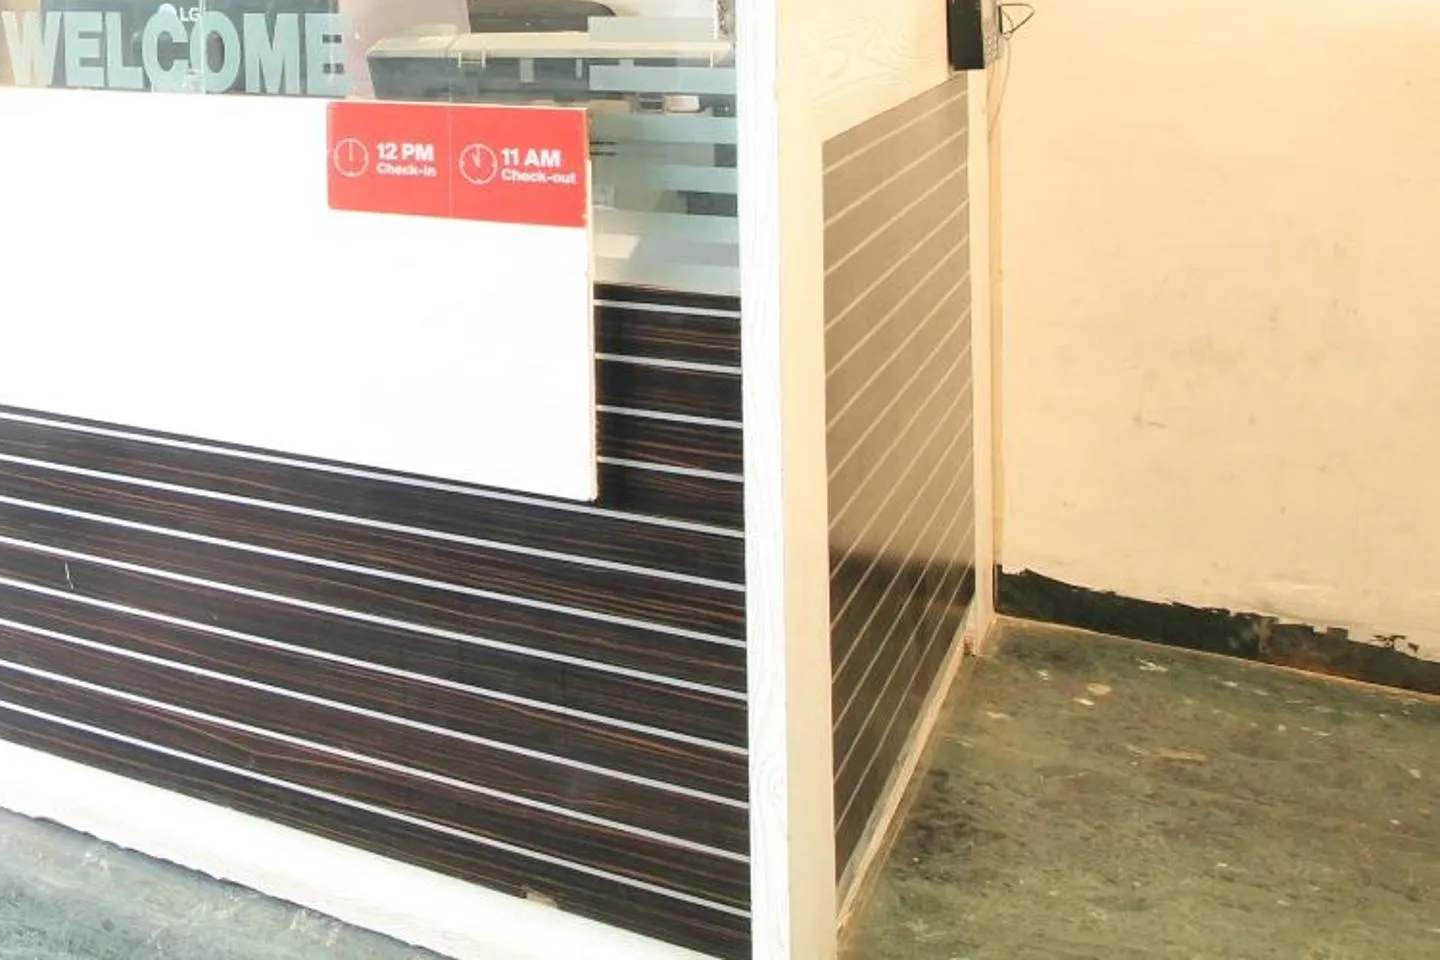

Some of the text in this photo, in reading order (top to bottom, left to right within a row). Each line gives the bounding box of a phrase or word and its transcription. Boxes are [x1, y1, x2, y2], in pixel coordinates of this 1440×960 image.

[179, 6, 201, 22] LG
[2, 9, 348, 96] WELCOME
[376, 142, 435, 162] 12 PM
[501, 147, 561, 168] 11 AM
[376, 162, 437, 177] Check-in
[501, 169, 576, 185] Check-out
